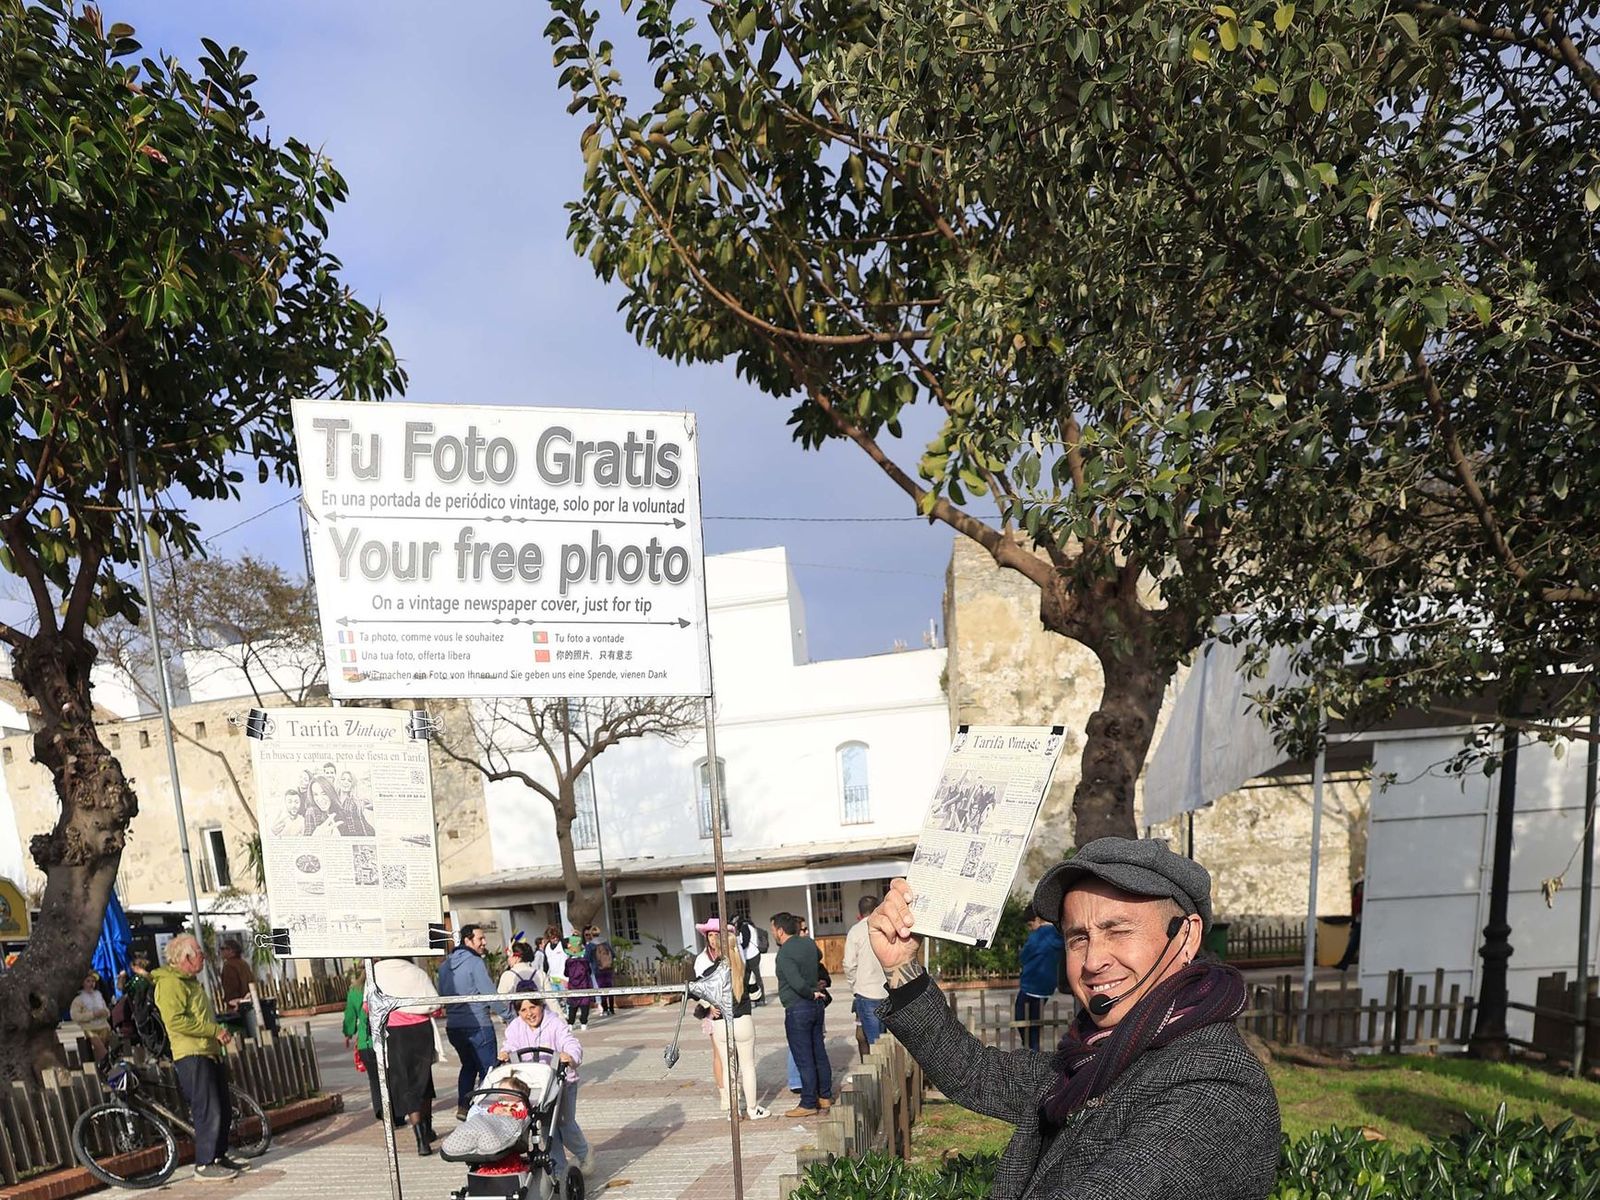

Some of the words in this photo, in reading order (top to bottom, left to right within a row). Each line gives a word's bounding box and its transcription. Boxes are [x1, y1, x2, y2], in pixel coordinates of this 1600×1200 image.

[312, 418, 380, 481] Tu
[403, 421, 517, 484] Foto
[536, 426, 681, 488] Gratis
[322, 490, 337, 506] En
[342, 494, 365, 506] una
[370, 491, 421, 511] portada
[425, 491, 441, 508] de
[445, 492, 506, 512] periódico
[510, 494, 559, 514] vintage,
[563, 495, 589, 512] solo
[594, 500, 615, 515] por
[618, 496, 629, 512] la
[633, 497, 685, 514] voluntad
[329, 526, 440, 581] Your
[454, 525, 543, 582] free
[559, 529, 691, 597] photo
[372, 594, 392, 611] On
[397, 598, 405, 611] a
[409, 595, 460, 614] vintage
[464, 598, 537, 615] newspaper
[541, 599, 580, 614] cover,
[582, 596, 608, 615] just
[613, 596, 632, 612] for
[635, 597, 652, 615] tip
[360, 632, 369, 642] Ta
[371, 631, 399, 643] photo,
[401, 634, 432, 642] comme
[434, 634, 453, 642] vous
[455, 632, 463, 642] le
[465, 632, 504, 642] souhaitez
[555, 633, 564, 643] Tu
[567, 633, 584, 643] foto
[586, 635, 591, 643] a
[592, 633, 625, 644] vontade
[361, 651, 378, 661] Una
[380, 652, 394, 661] tua
[396, 650, 416, 661] foto,
[417, 650, 446, 661] offerta
[448, 650, 471, 661] libera
[380, 669, 412, 680] machen
[429, 670, 448, 680] Foto
[450, 672, 465, 680] von
[467, 669, 491, 680] Ihnen
[492, 669, 509, 680] und
[510, 669, 523, 680] Sie
[525, 670, 550, 682] geben
[568, 670, 585, 679] eine
[587, 669, 618, 681] Spende,
[620, 670, 646, 679] vienen
[648, 669, 668, 679] Dank
[286, 719, 340, 738] Tarifa
[344, 719, 397, 741] Vintage
[973, 735, 1005, 749] Tarifa
[1008, 736, 1041, 753] Vintage
[260, 751, 271, 760] En
[272, 750, 295, 760] busca
[296, 753, 302, 763] y
[303, 752, 333, 762] captura,
[335, 753, 353, 763] pero
[355, 750, 365, 761] de
[367, 750, 388, 761] fiesta
[389, 753, 400, 761] en
[401, 752, 426, 763] Tarifa
